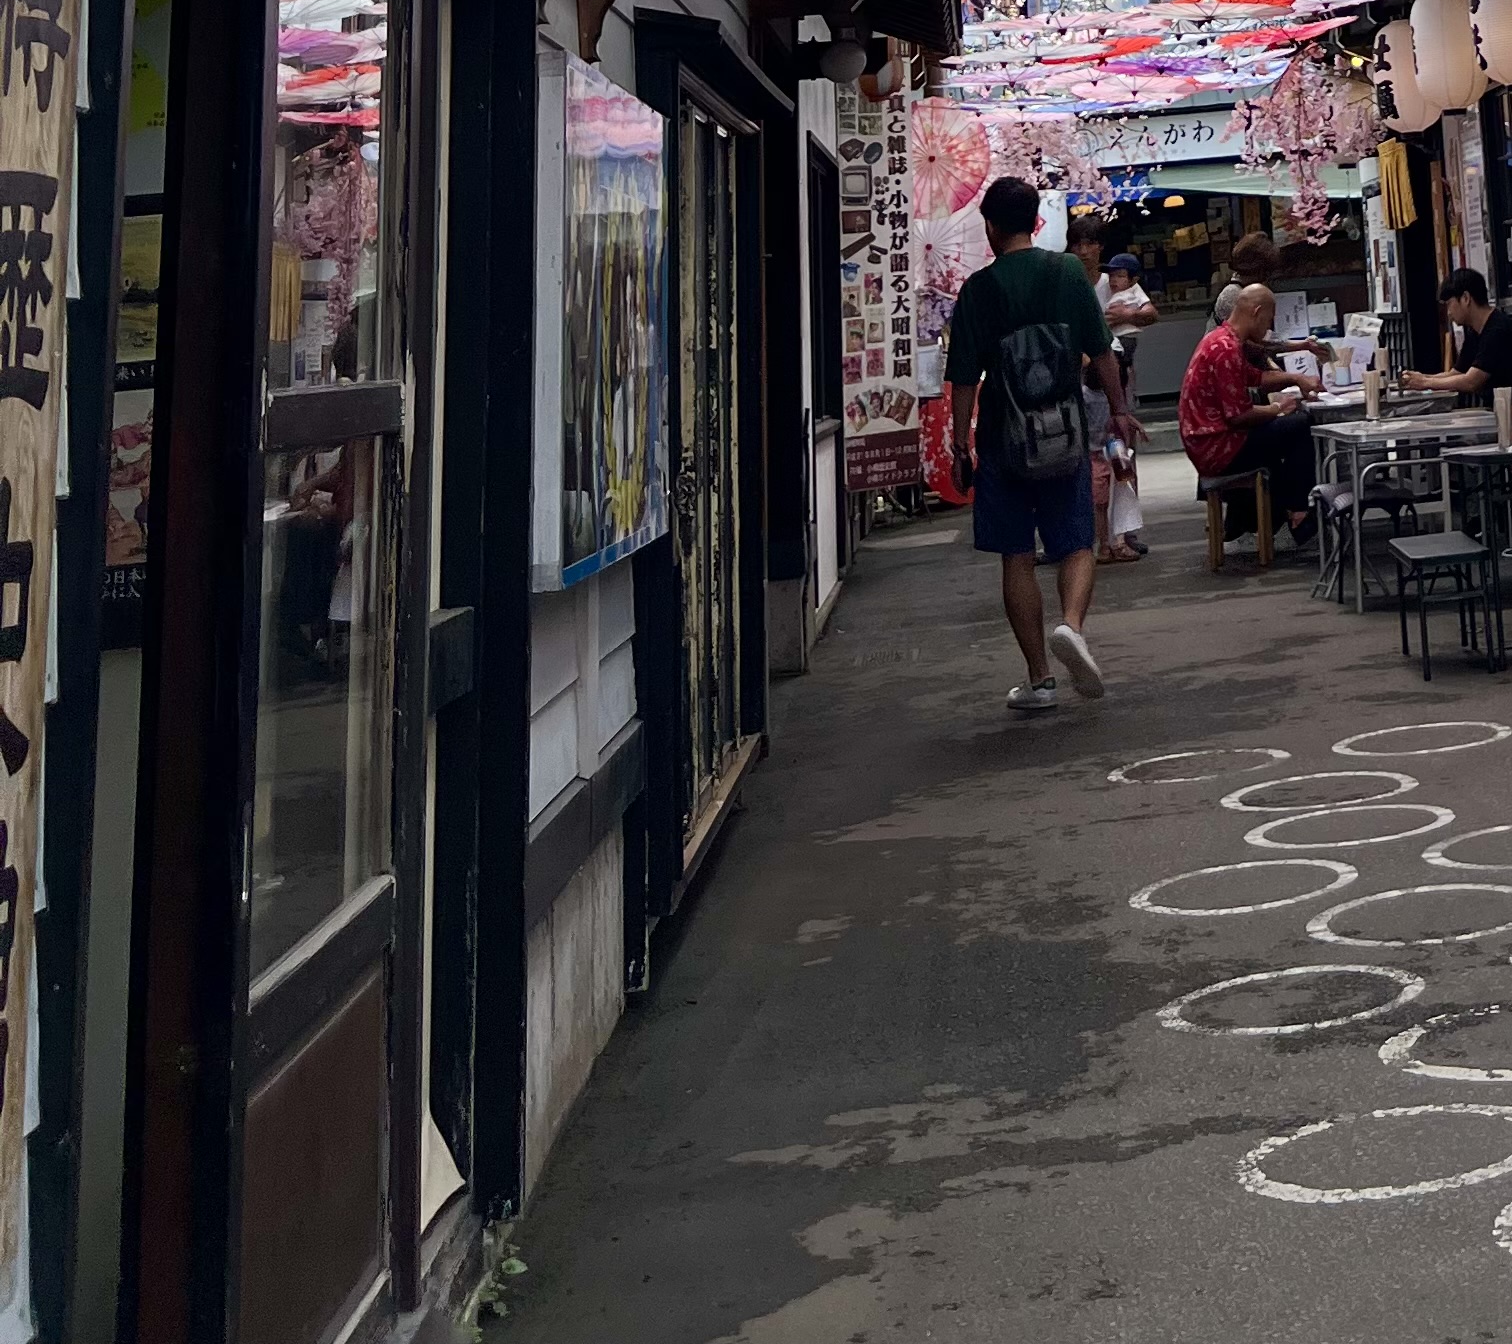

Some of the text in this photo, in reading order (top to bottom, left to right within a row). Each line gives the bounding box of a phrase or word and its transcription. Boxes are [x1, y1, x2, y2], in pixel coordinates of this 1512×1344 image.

[887, 75, 915, 379] 真と雑誌・小物が語る大昭和展
